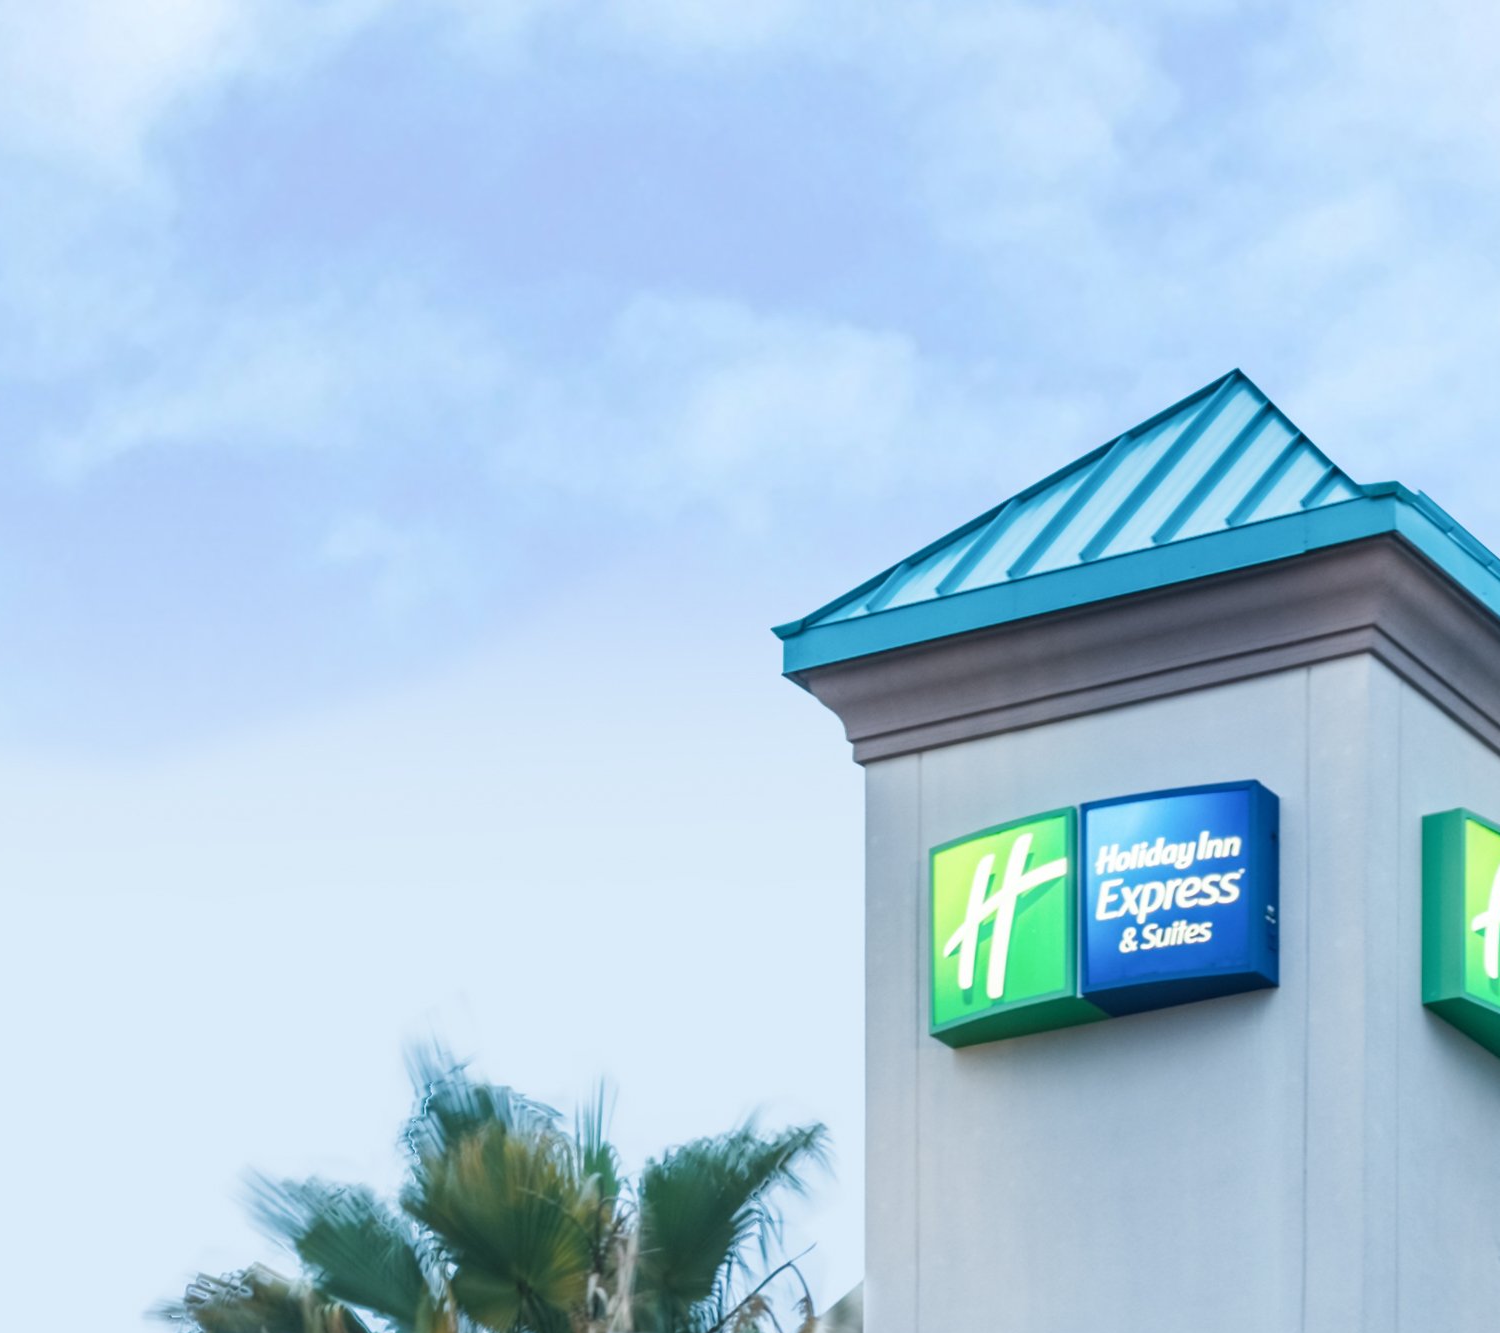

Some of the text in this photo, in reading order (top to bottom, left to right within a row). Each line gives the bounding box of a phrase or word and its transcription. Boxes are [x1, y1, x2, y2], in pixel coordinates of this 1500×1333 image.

[1095, 831, 1242, 876] Holiday Inn
[1095, 870, 1241, 924] Express
[1119, 920, 1212, 953] & Suites
